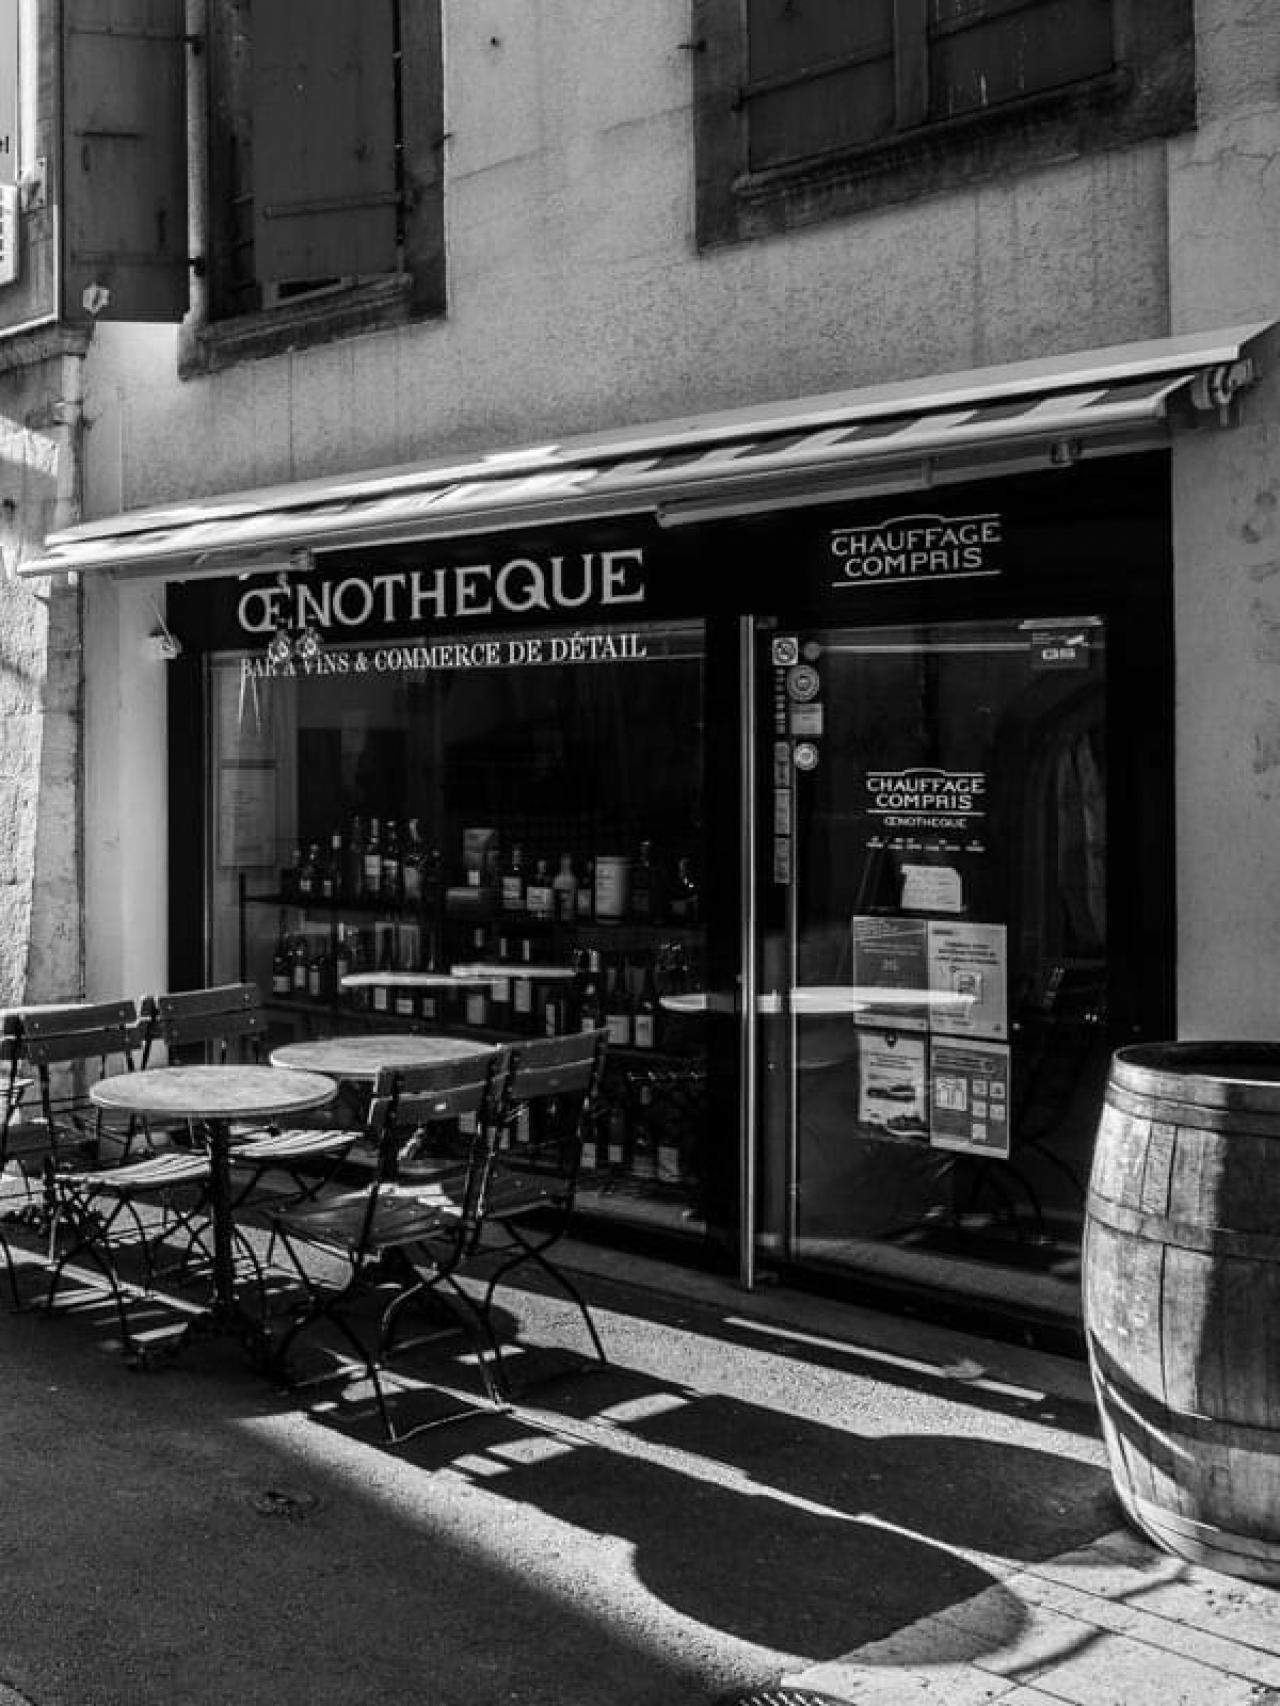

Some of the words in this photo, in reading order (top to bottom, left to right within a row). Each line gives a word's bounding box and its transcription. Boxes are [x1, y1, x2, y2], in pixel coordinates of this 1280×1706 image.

[831, 521, 1003, 556] CHAUFFAGE
[844, 547, 983, 578] COMPRIS
[355, 651, 368, 673] &
[374, 642, 501, 673] COMMERCE
[508, 639, 543, 664] DE
[551, 631, 648, 662] DÉTAIL
[867, 777, 986, 794] CHAUFFAGE
[876, 794, 972, 810] COMPRIS
